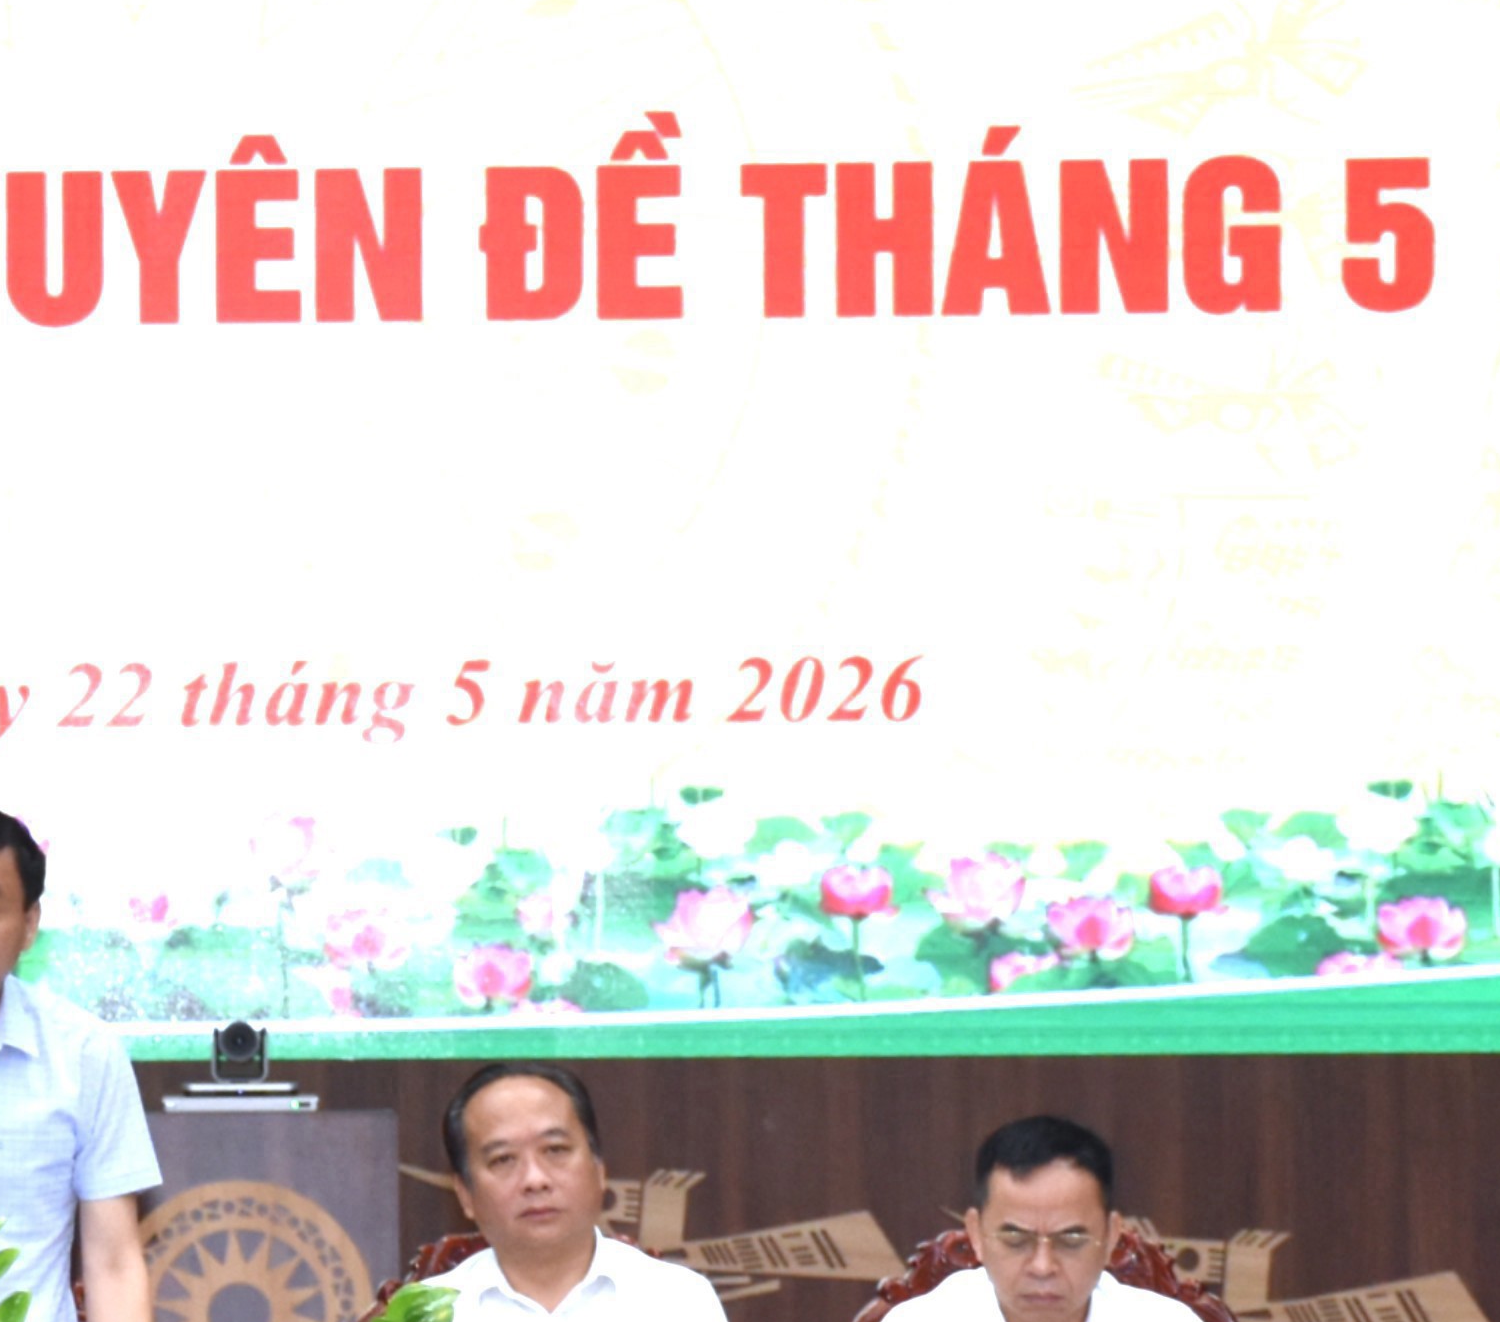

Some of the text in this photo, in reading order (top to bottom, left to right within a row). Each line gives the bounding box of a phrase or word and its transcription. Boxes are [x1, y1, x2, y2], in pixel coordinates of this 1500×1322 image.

[479, 111, 683, 321] ĐỀ
[740, 125, 1282, 318] THÁNG
[1342, 157, 1435, 313] 5
[60, 664, 151, 726] 22
[182, 661, 411, 740] tháng
[447, 660, 489, 725] 5
[519, 664, 692, 723] năm
[728, 656, 921, 722] 2026
